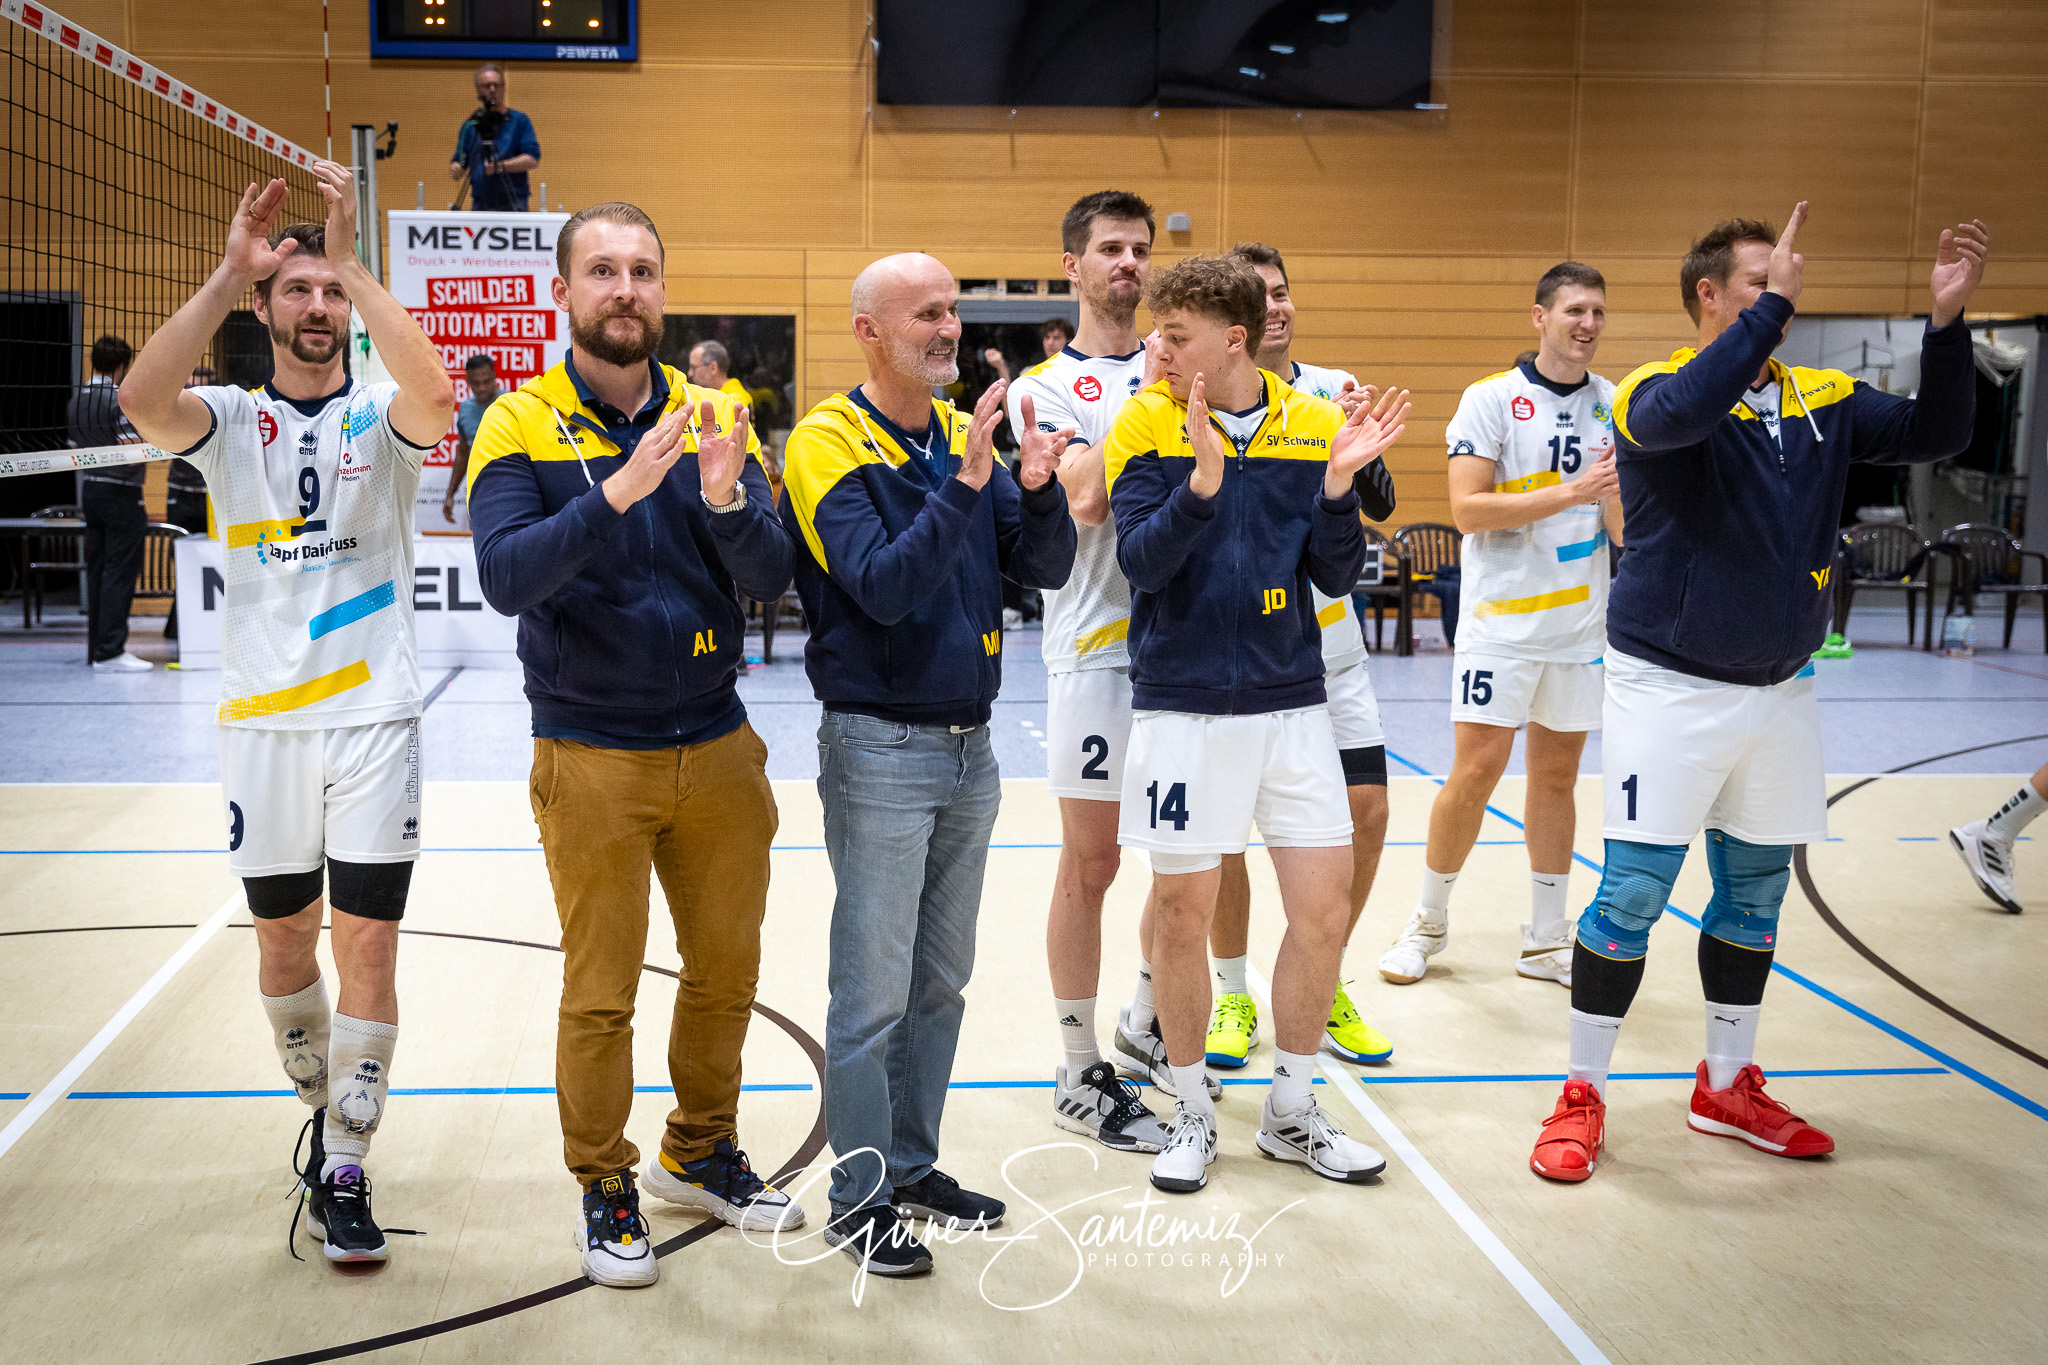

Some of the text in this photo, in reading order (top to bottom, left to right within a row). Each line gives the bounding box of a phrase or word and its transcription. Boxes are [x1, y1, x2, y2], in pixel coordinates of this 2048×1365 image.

[556, 46, 619, 59] PEWETA
[408, 226, 553, 251] MEYSEL
[407, 255, 551, 268] Druck Werbetechnik
[432, 278, 529, 306] SCHILDER
[1267, 434, 1327, 448] SV Schwaig
[1548, 435, 1582, 474] 15
[299, 466, 321, 519] 9
[1262, 588, 1287, 615] JD
[693, 629, 718, 657] AL
[1462, 670, 1493, 706] 15
[1081, 735, 1109, 780] 2
[1147, 780, 1189, 831] 14
[1622, 774, 1638, 821] 1
[286, 1038, 309, 1050] errea
[355, 1073, 379, 1084] errea
